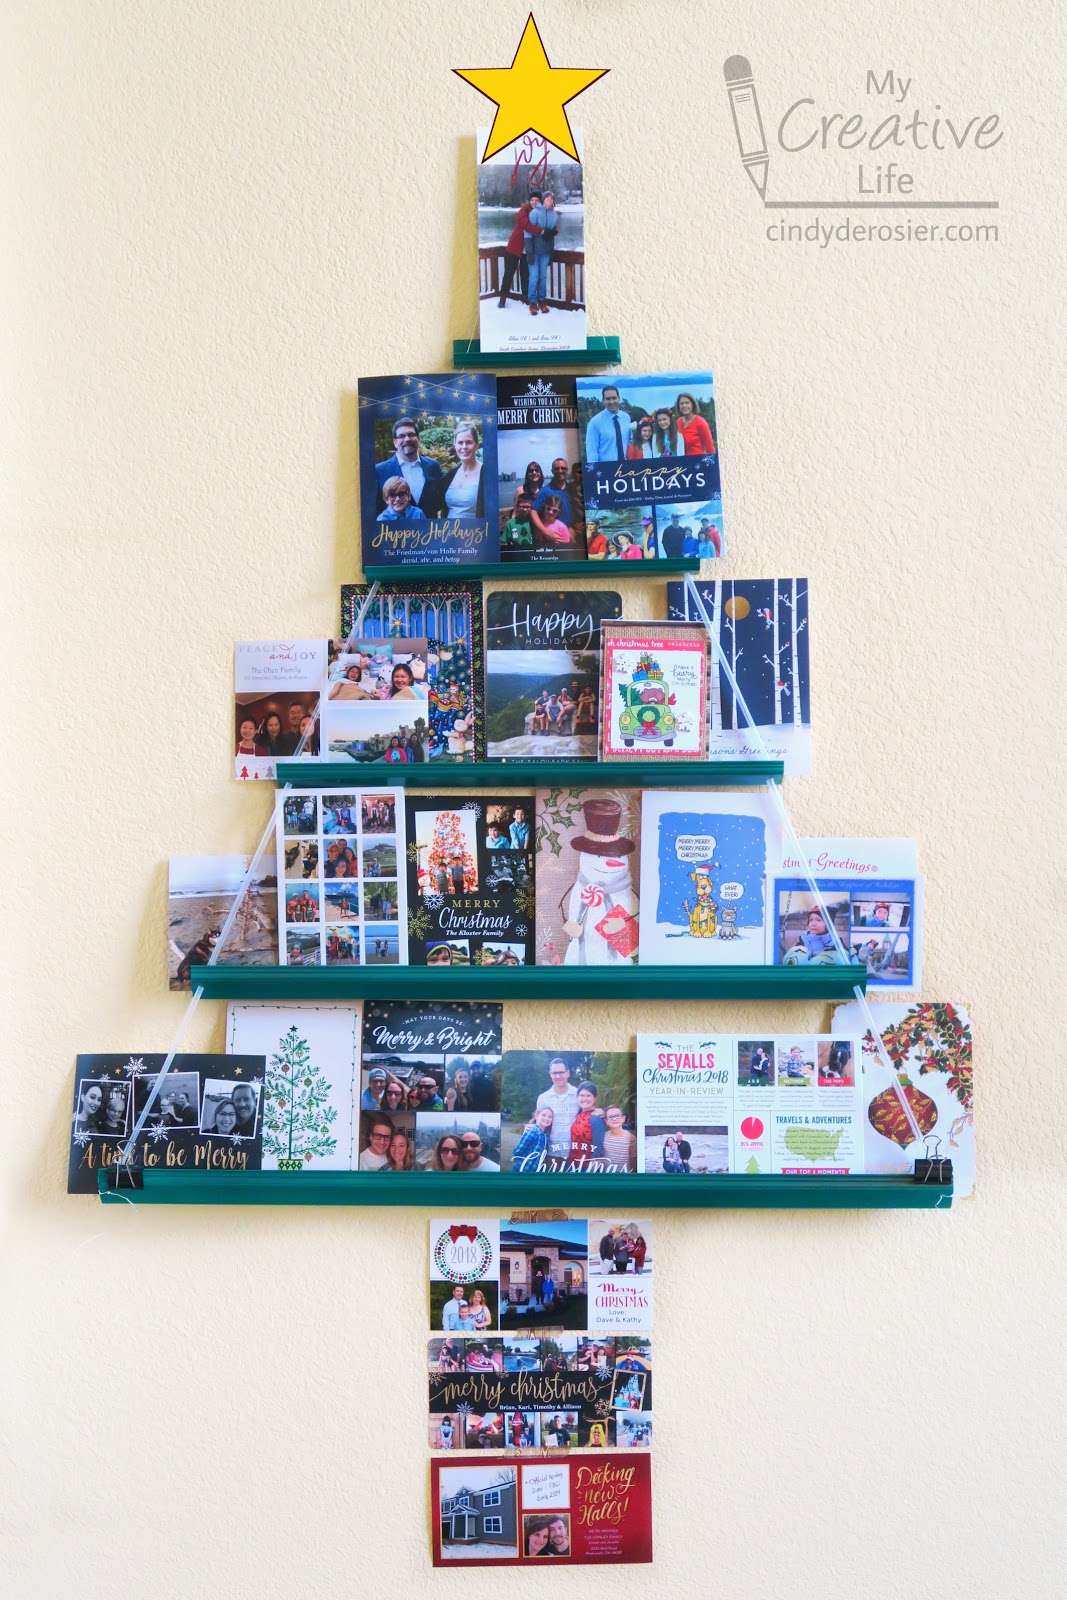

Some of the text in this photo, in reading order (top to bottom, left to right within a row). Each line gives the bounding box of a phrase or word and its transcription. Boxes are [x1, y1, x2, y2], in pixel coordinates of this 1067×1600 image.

[513, 397, 568, 407] WISHING YOU A VERY
[497, 408, 529, 425] MERRY
[614, 463, 688, 486] happy
[596, 472, 706, 495] HOLIDAYS
[371, 518, 489, 549] Happy Holidays!
[396, 548, 439, 556] Friedman/von
[457, 548, 478, 556] Family
[488, 602, 601, 656] Happy
[239, 644, 279, 653] PEACE
[525, 637, 582, 645] HOLIDAYS
[607, 639, 664, 648] oh christmas tree
[269, 644, 317, 661] and JOY
[738, 745, 789, 758] Greeings
[783, 852, 871, 874] stms Greetings
[451, 899, 501, 908] MERRY
[438, 907, 514, 930] Christmas
[482, 929, 504, 937] Family
[372, 1025, 497, 1052] Merry & Bright
[676, 1044, 695, 1052] THE
[657, 1053, 715, 1069] SEVALLS
[642, 1067, 729, 1084] Christmas 2018
[649, 1087, 724, 1095] YEAR-IN-REVIEW
[776, 1116, 852, 1124] TRAVELS & ADVENTURES
[78, 1142, 96, 1170] A
[142, 1142, 161, 1167] to
[166, 1140, 188, 1167] be
[193, 1139, 249, 1170] Merry
[551, 1142, 598, 1153] MERRY
[511, 1149, 634, 1173] Christmas
[450, 1246, 477, 1264] 2018
[597, 1283, 644, 1295] Merry
[595, 1295, 649, 1308] CHRISTMAS
[434, 1366, 606, 1409] merry christmas
[575, 1462, 636, 1495] Decking
[584, 1485, 615, 1504] new
[578, 1497, 630, 1527] Halls!
